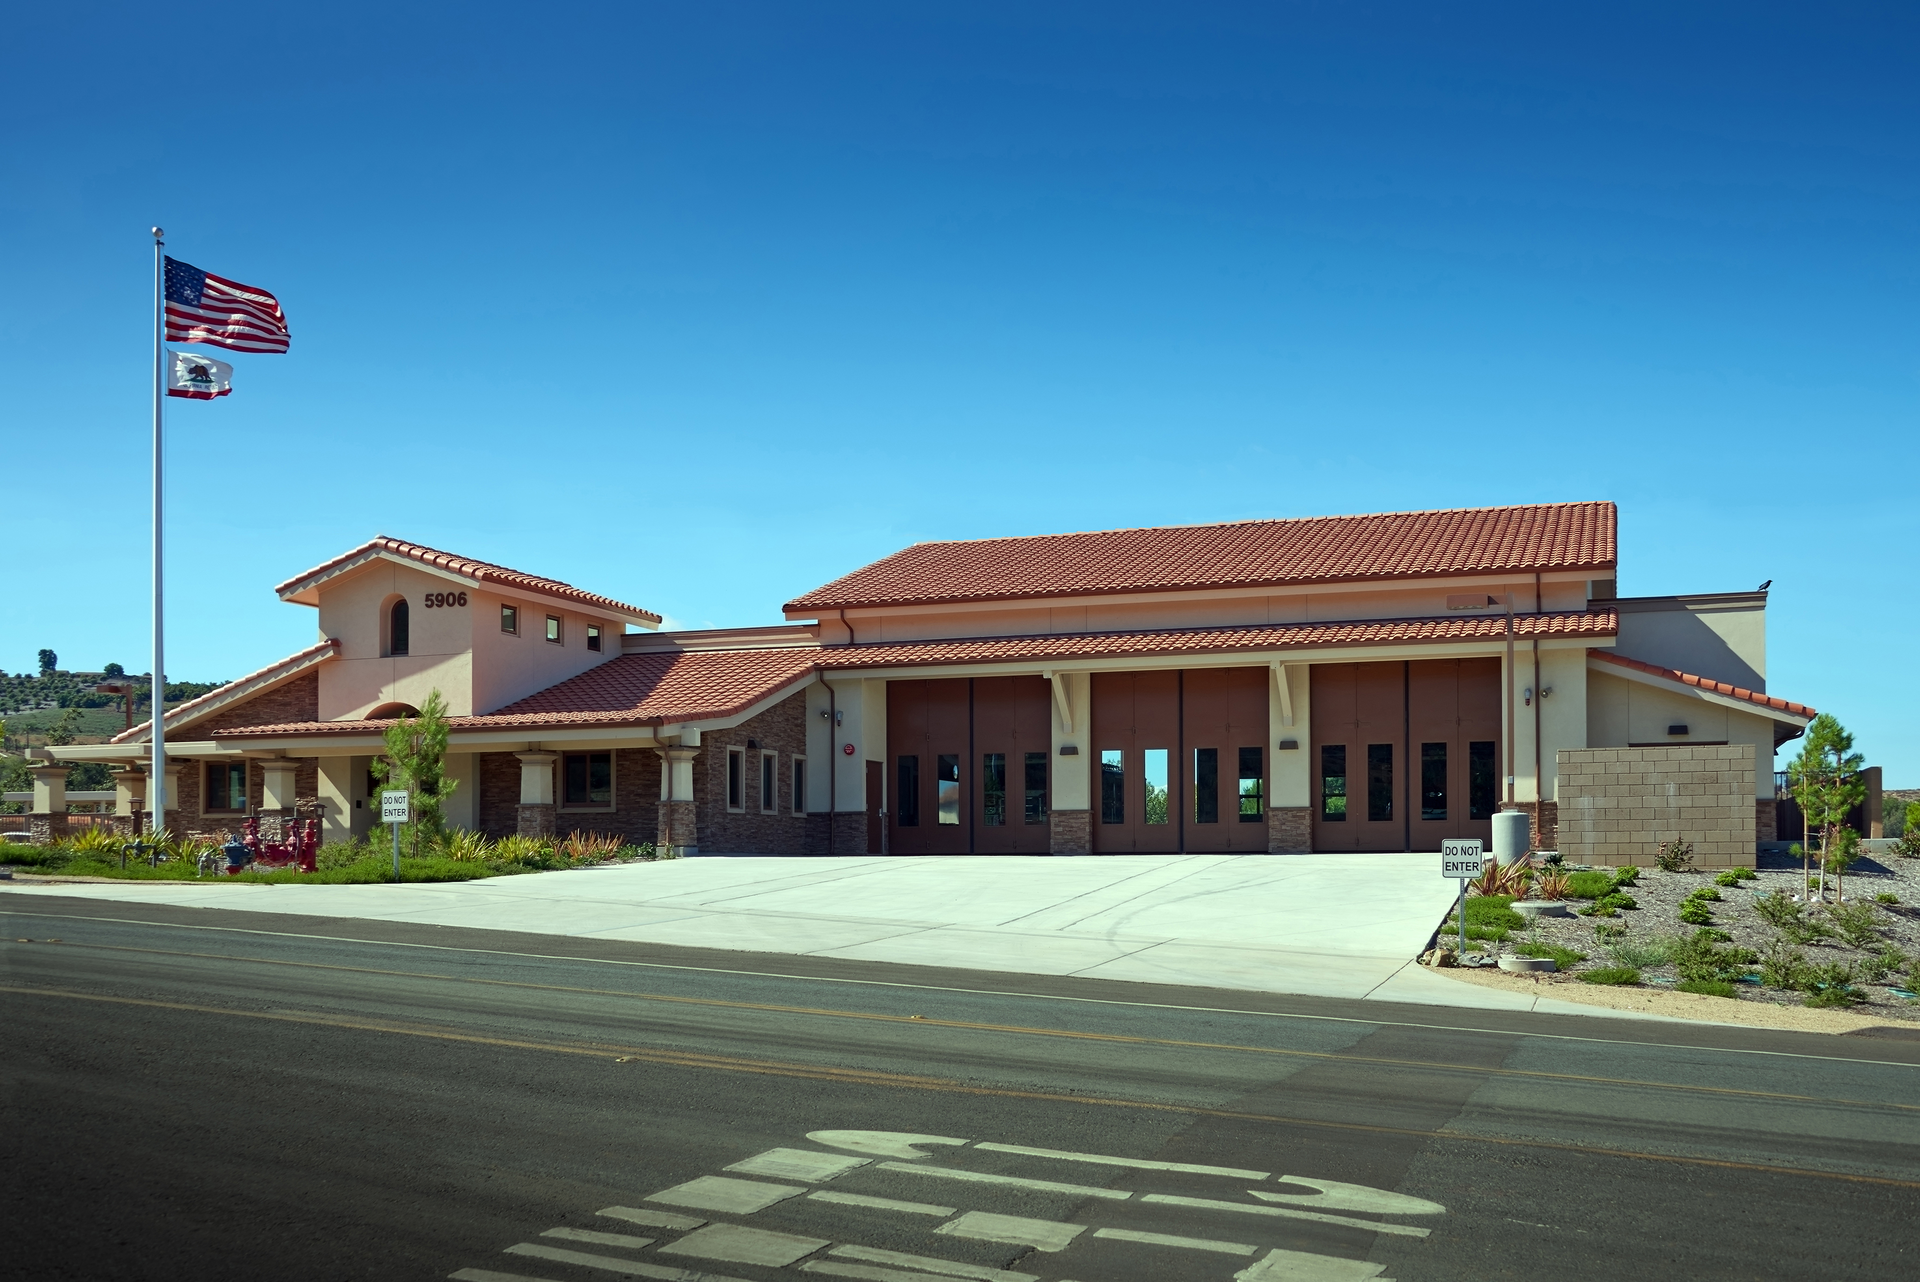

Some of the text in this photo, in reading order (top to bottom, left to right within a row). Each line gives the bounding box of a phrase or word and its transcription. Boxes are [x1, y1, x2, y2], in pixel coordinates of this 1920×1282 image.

[425, 591, 467, 608] 5906
[384, 796, 406, 804] DO NOT
[384, 808, 406, 816] ENTER
[1445, 846, 1479, 856] DO NOT
[1445, 862, 1479, 871] ENTER
